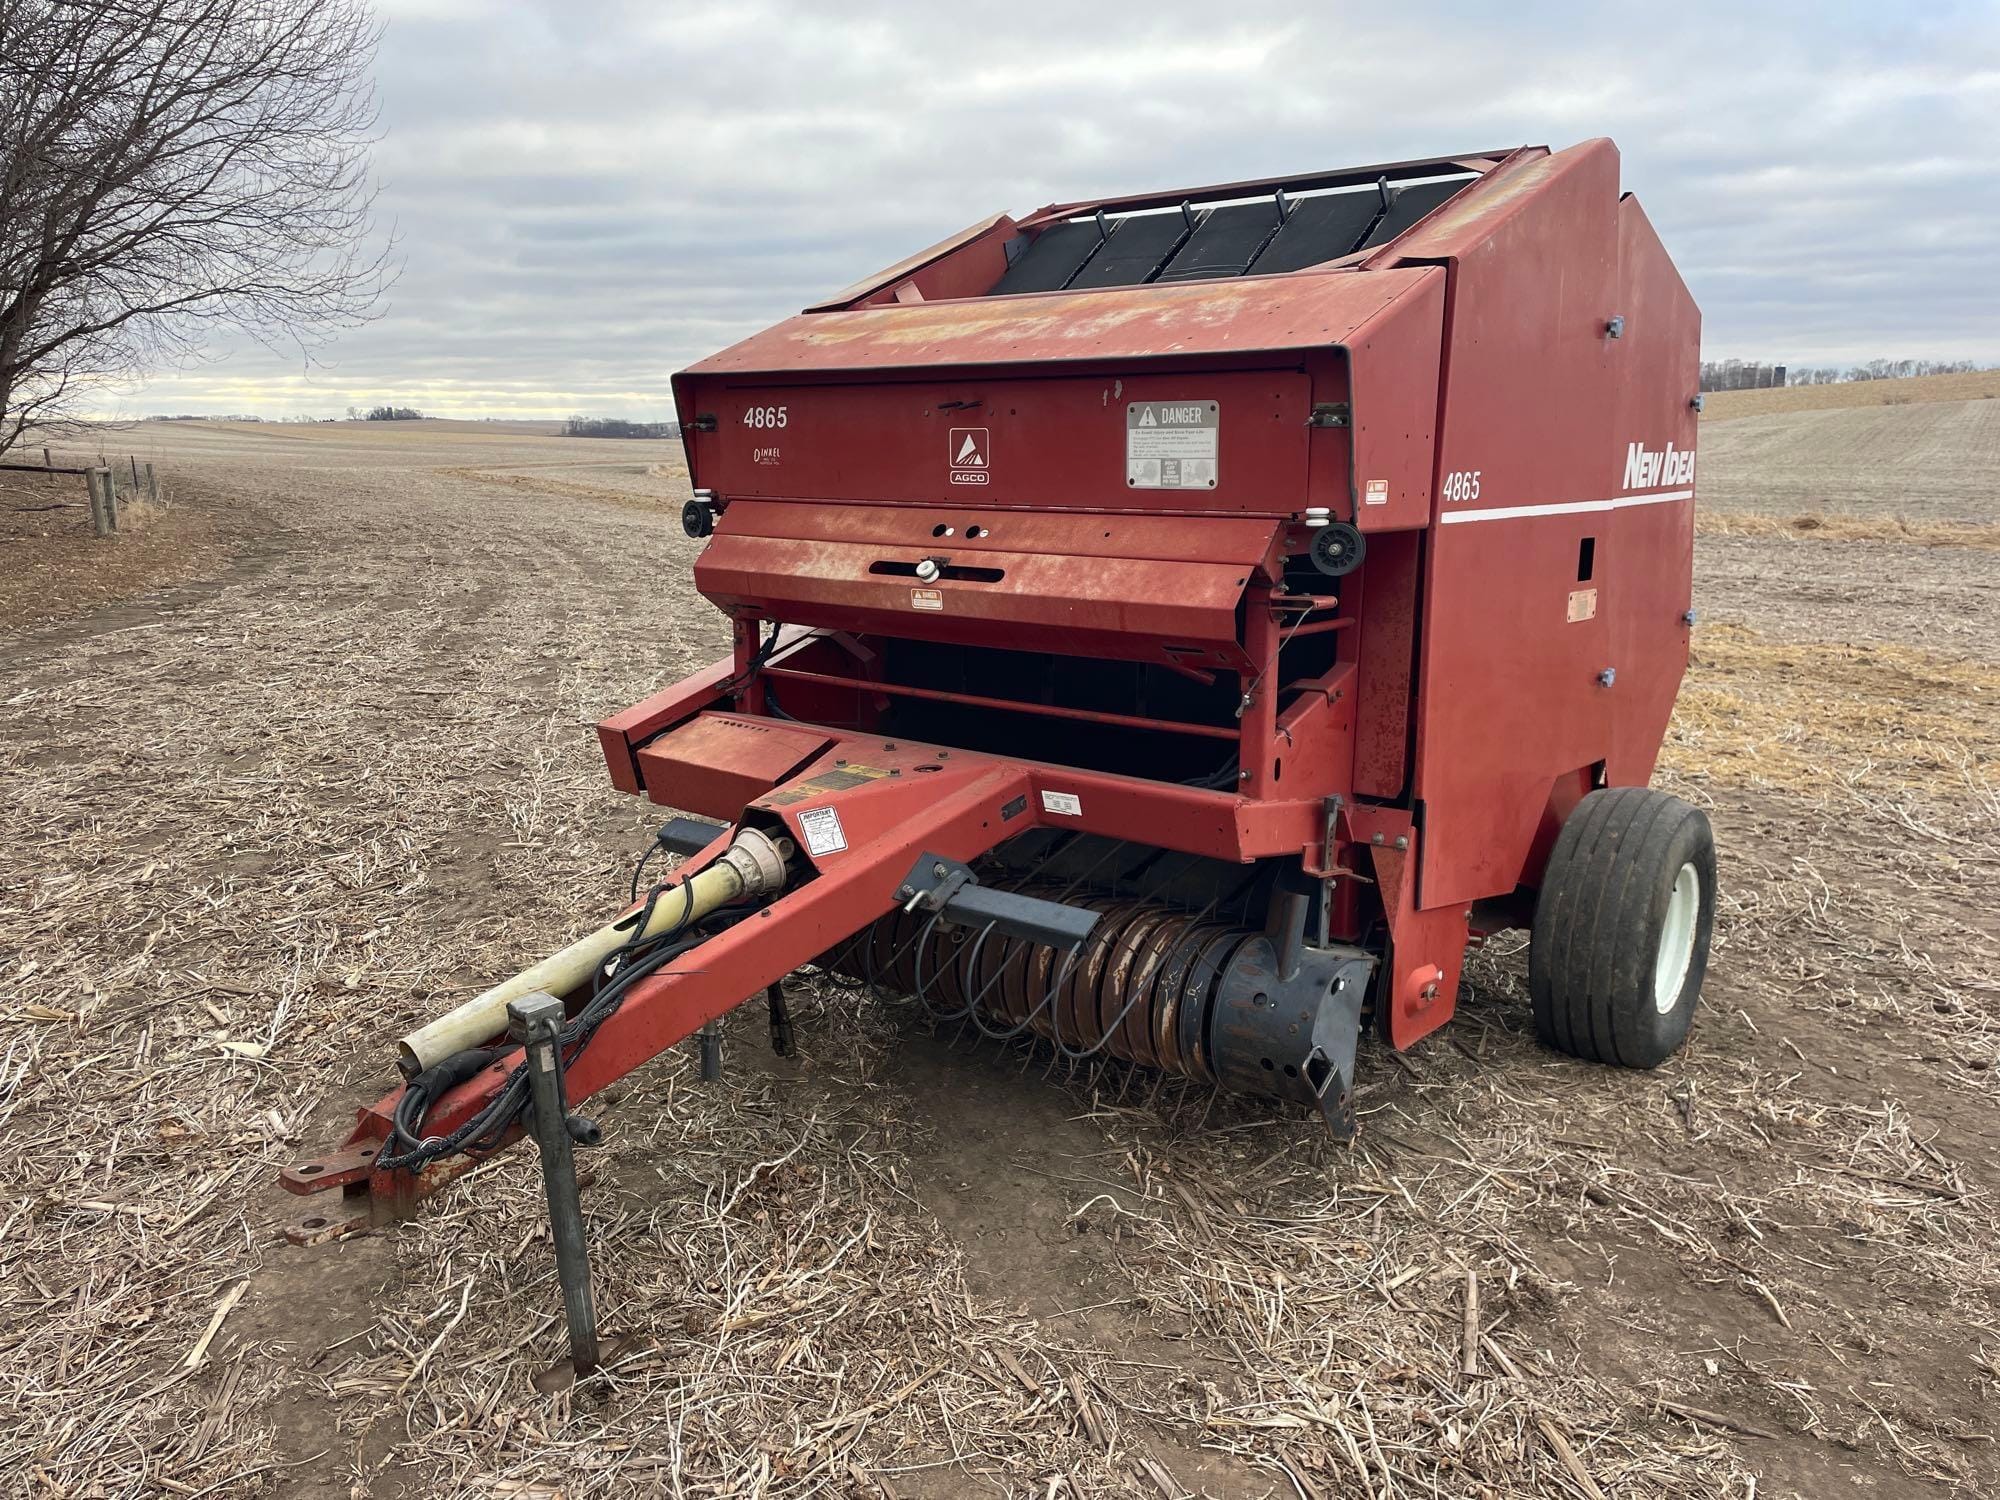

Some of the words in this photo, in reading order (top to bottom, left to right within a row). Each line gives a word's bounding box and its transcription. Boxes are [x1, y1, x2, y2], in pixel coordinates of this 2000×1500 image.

[743, 406, 788, 428] 4865
[1161, 407, 1202, 424] DANGER
[1622, 442, 1664, 490] NEW
[1661, 441, 1696, 486] IDEA
[954, 474, 986, 482] AGCO
[1443, 471, 1481, 501] 4865
[803, 809, 832, 820] IMPORTANT
